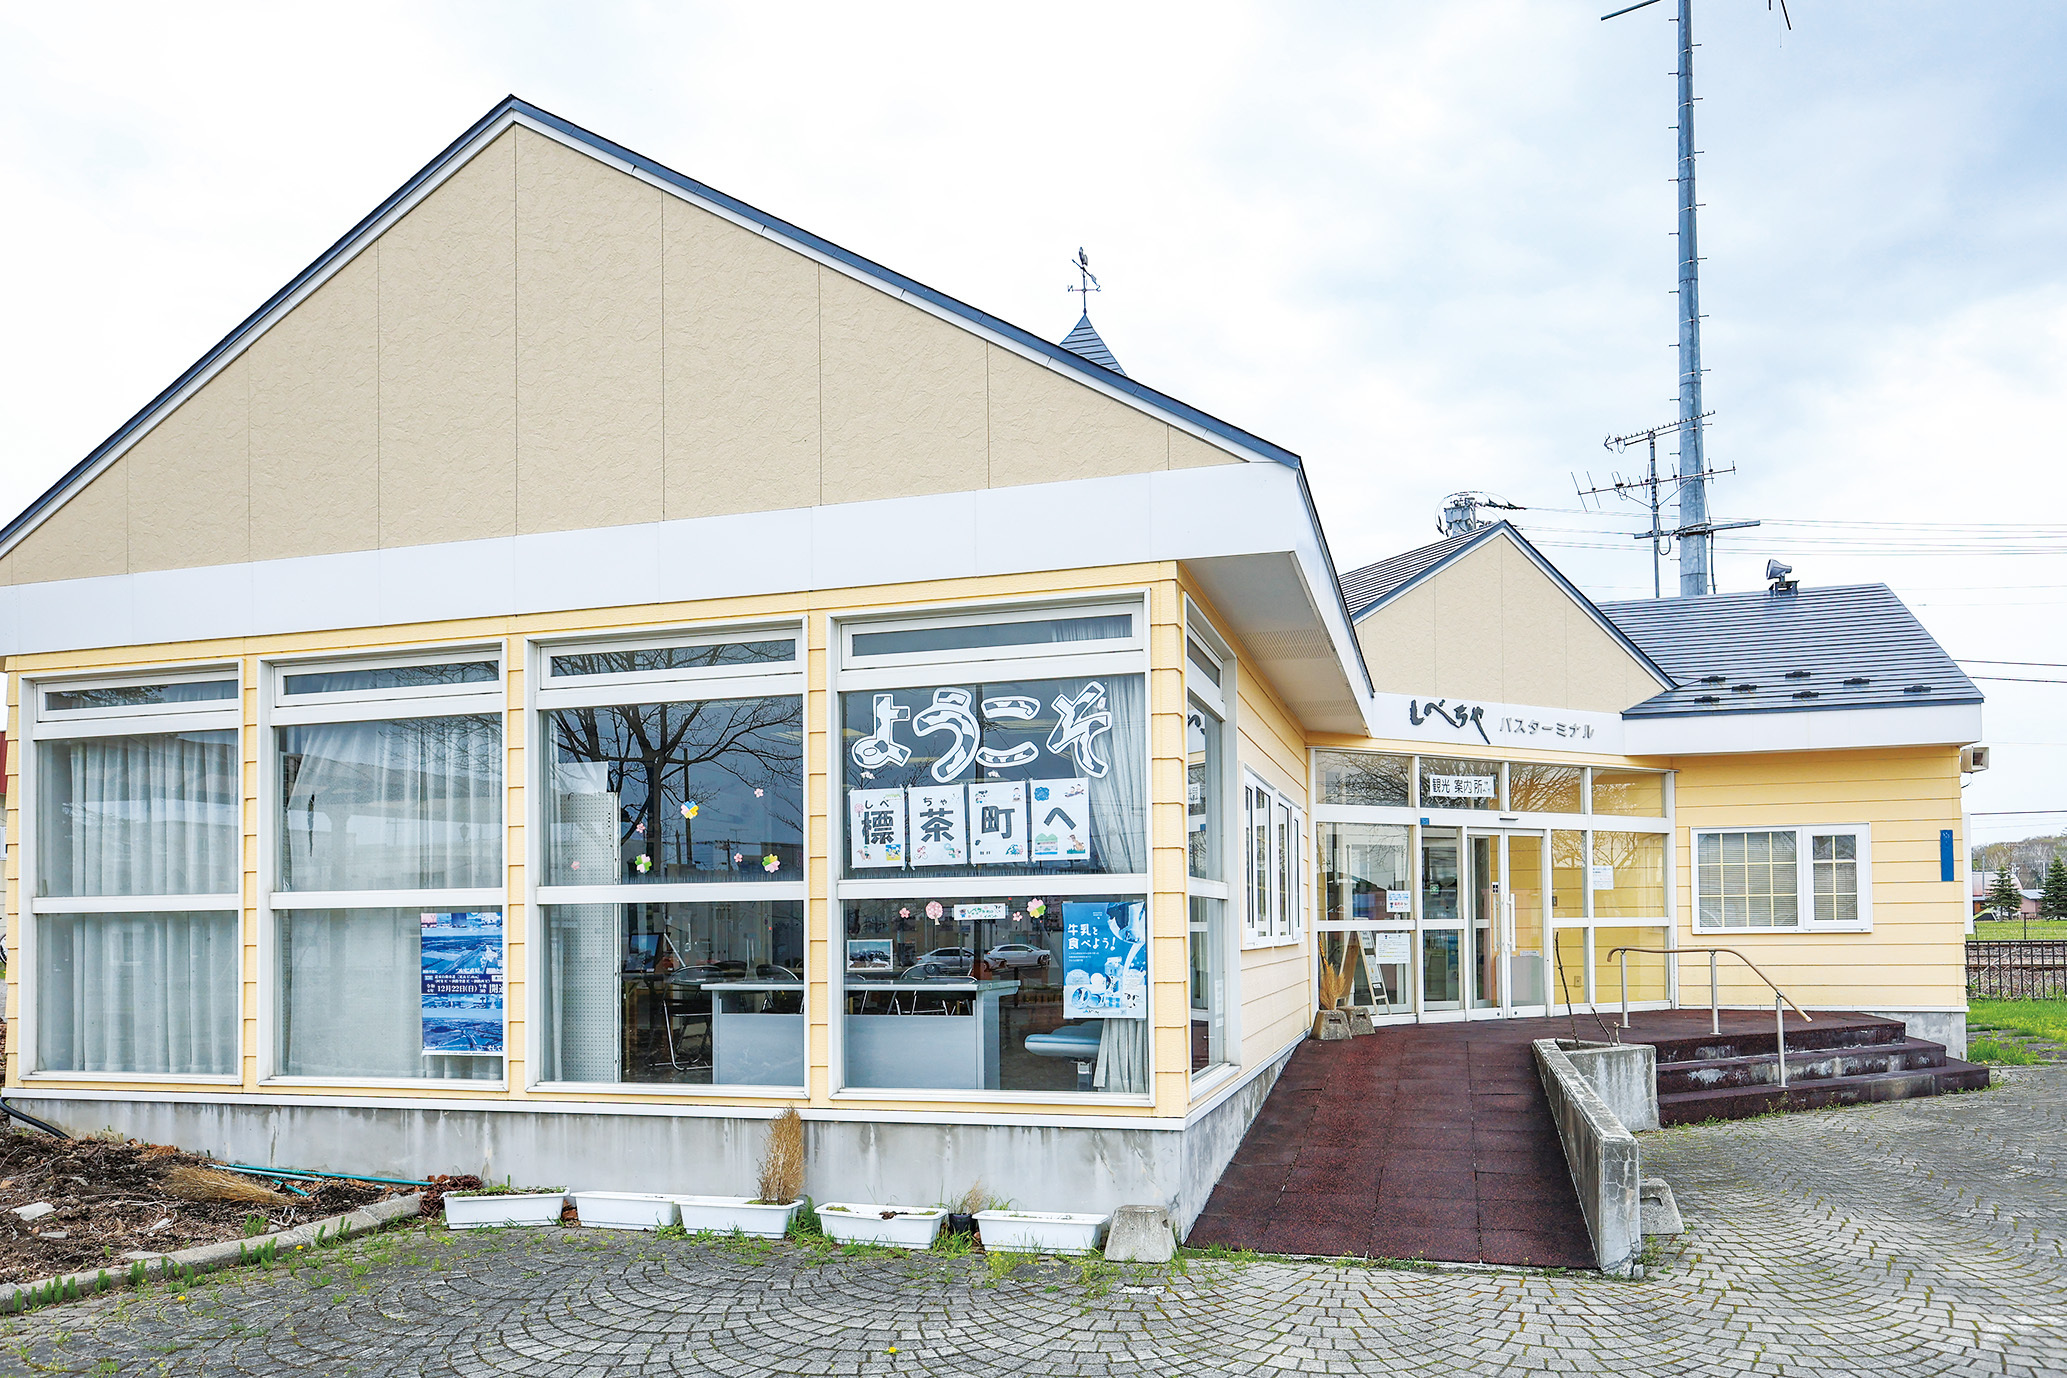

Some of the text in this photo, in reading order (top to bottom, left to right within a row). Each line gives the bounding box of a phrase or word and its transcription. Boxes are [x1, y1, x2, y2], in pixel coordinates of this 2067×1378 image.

[852, 681, 1113, 783] ようこそ
[1499, 716, 1595, 740] バスターミナル
[1067, 923, 1098, 936] 牛乳と
[1067, 937, 1116, 951] 食べよう!
